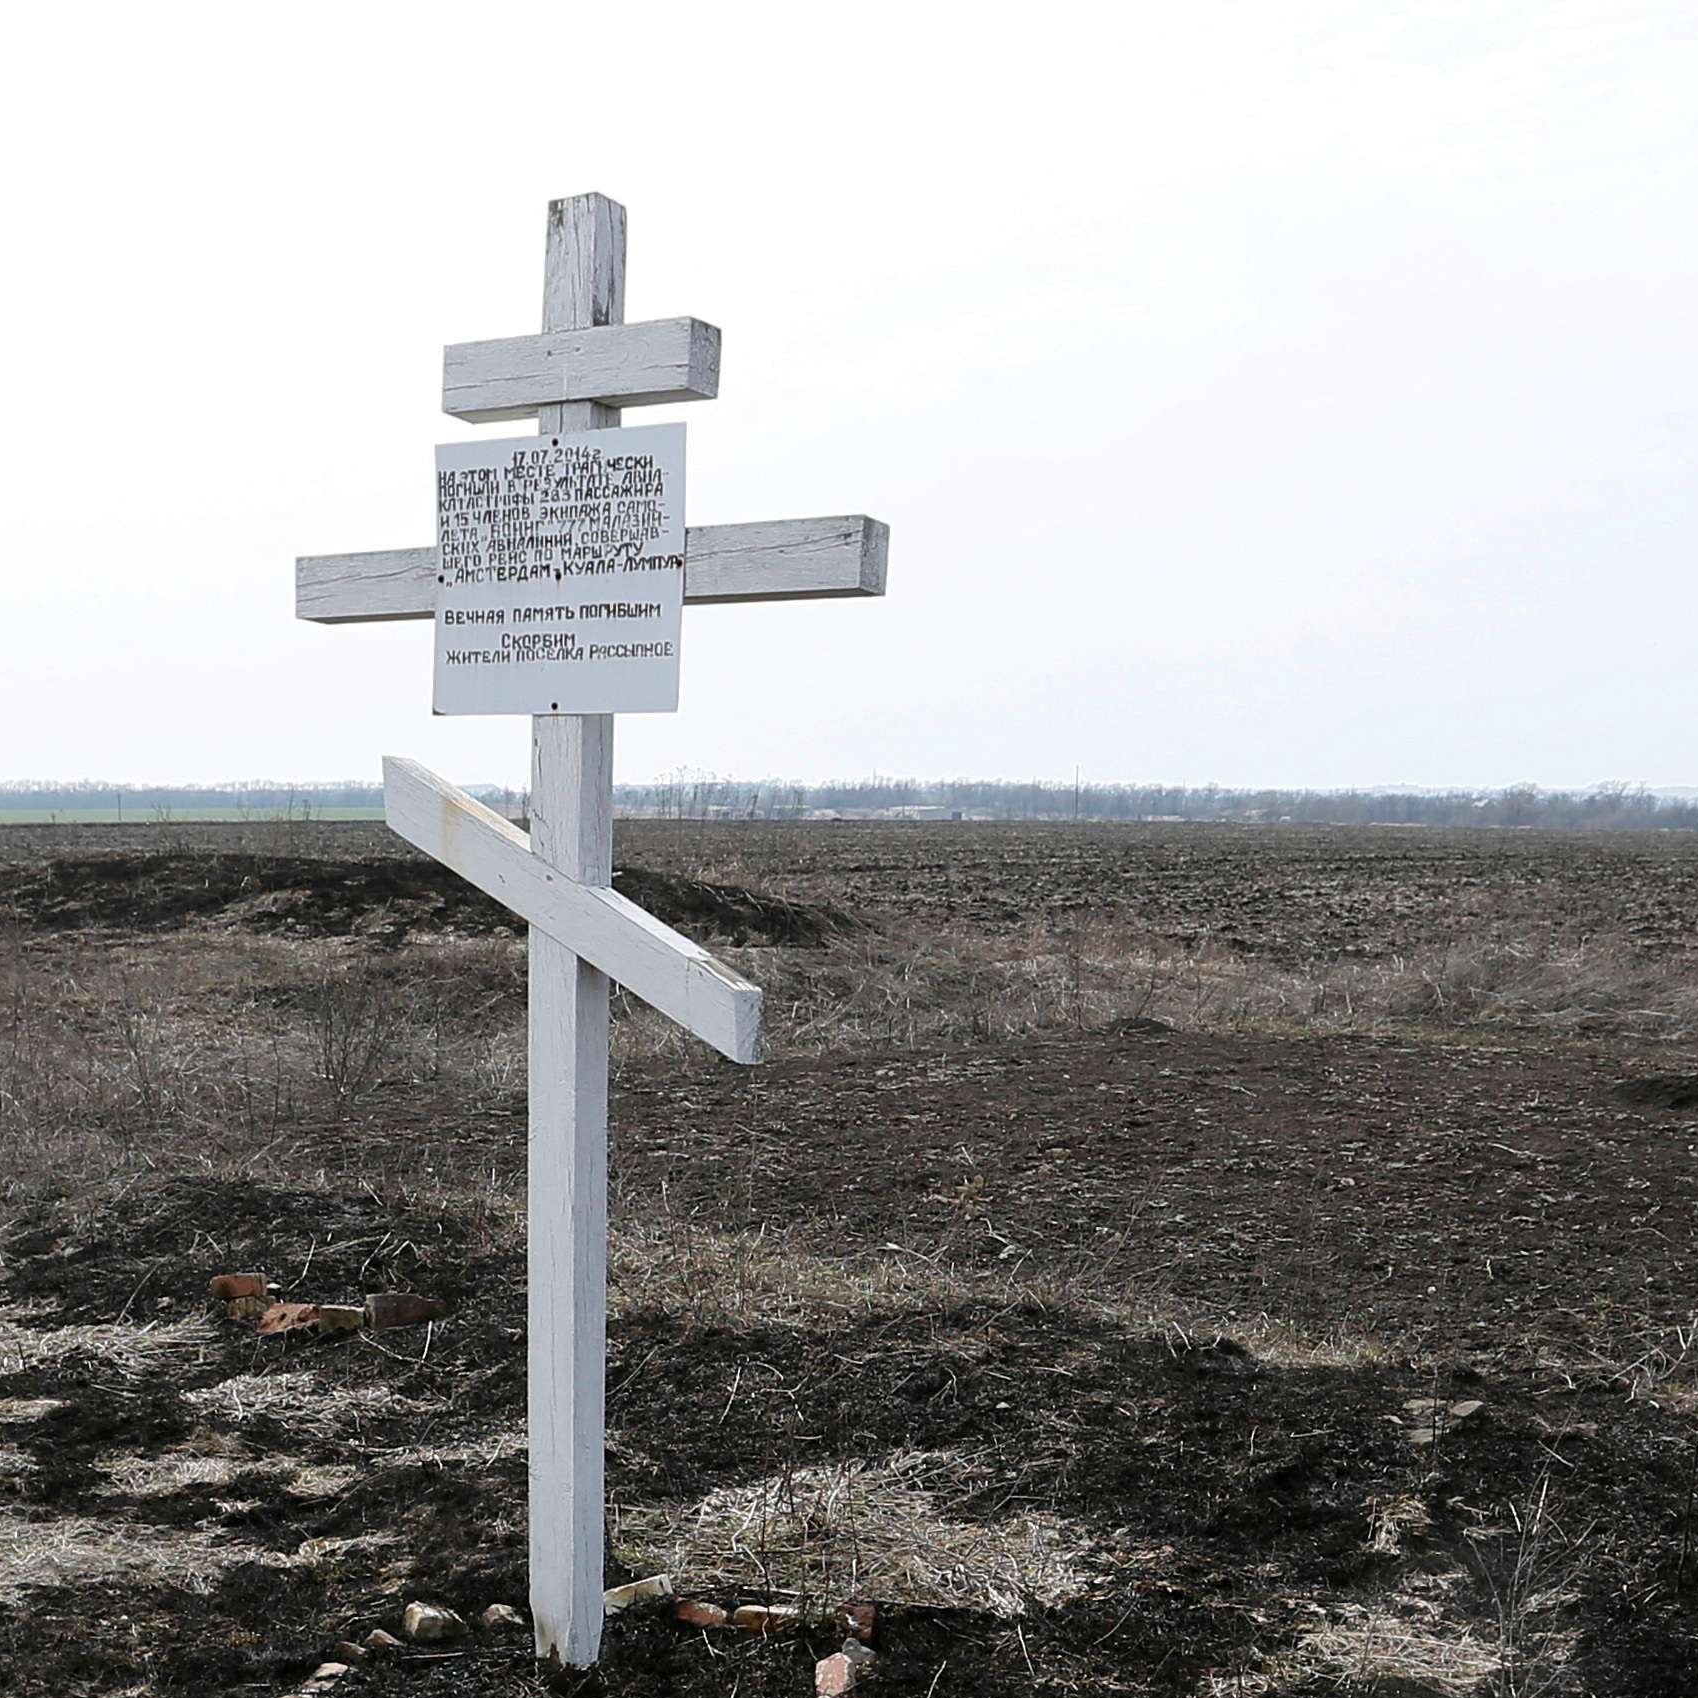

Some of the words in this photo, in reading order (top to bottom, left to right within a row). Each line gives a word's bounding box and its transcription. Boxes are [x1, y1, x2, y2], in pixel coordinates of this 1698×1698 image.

[438, 471, 455, 485] НА
[460, 468, 497, 482] ЭТОМ
[504, 464, 555, 479] МЕСТЕ
[508, 480, 515, 492] В
[540, 489, 571, 503] 283
[575, 482, 663, 501] ПАССАЖИРА
[441, 516, 449, 528] И
[454, 513, 469, 526] 15
[473, 507, 530, 524] ЧЛЕНОВ
[539, 501, 611, 520] ЭКИПАЖА
[441, 527, 477, 542] ЛЕТА
[557, 518, 585, 533] 777
[443, 541, 479, 556] СКИХ
[443, 555, 481, 570] ШЕГО
[535, 548, 552, 562] ПО
[561, 542, 643, 560] МАРШРУТУ
[445, 609, 504, 625] ВЕЧНАЯ
[513, 605, 575, 623] ПАМЯТЬ
[579, 603, 661, 619] ПОГИБШИМ
[501, 632, 575, 650] СКОРБИМ
[446, 650, 510, 665] ЖИТЕЛИ
[516, 646, 583, 662] ПОСЕЛКА
[589, 642, 674, 659] РАССЫПНОЕ
